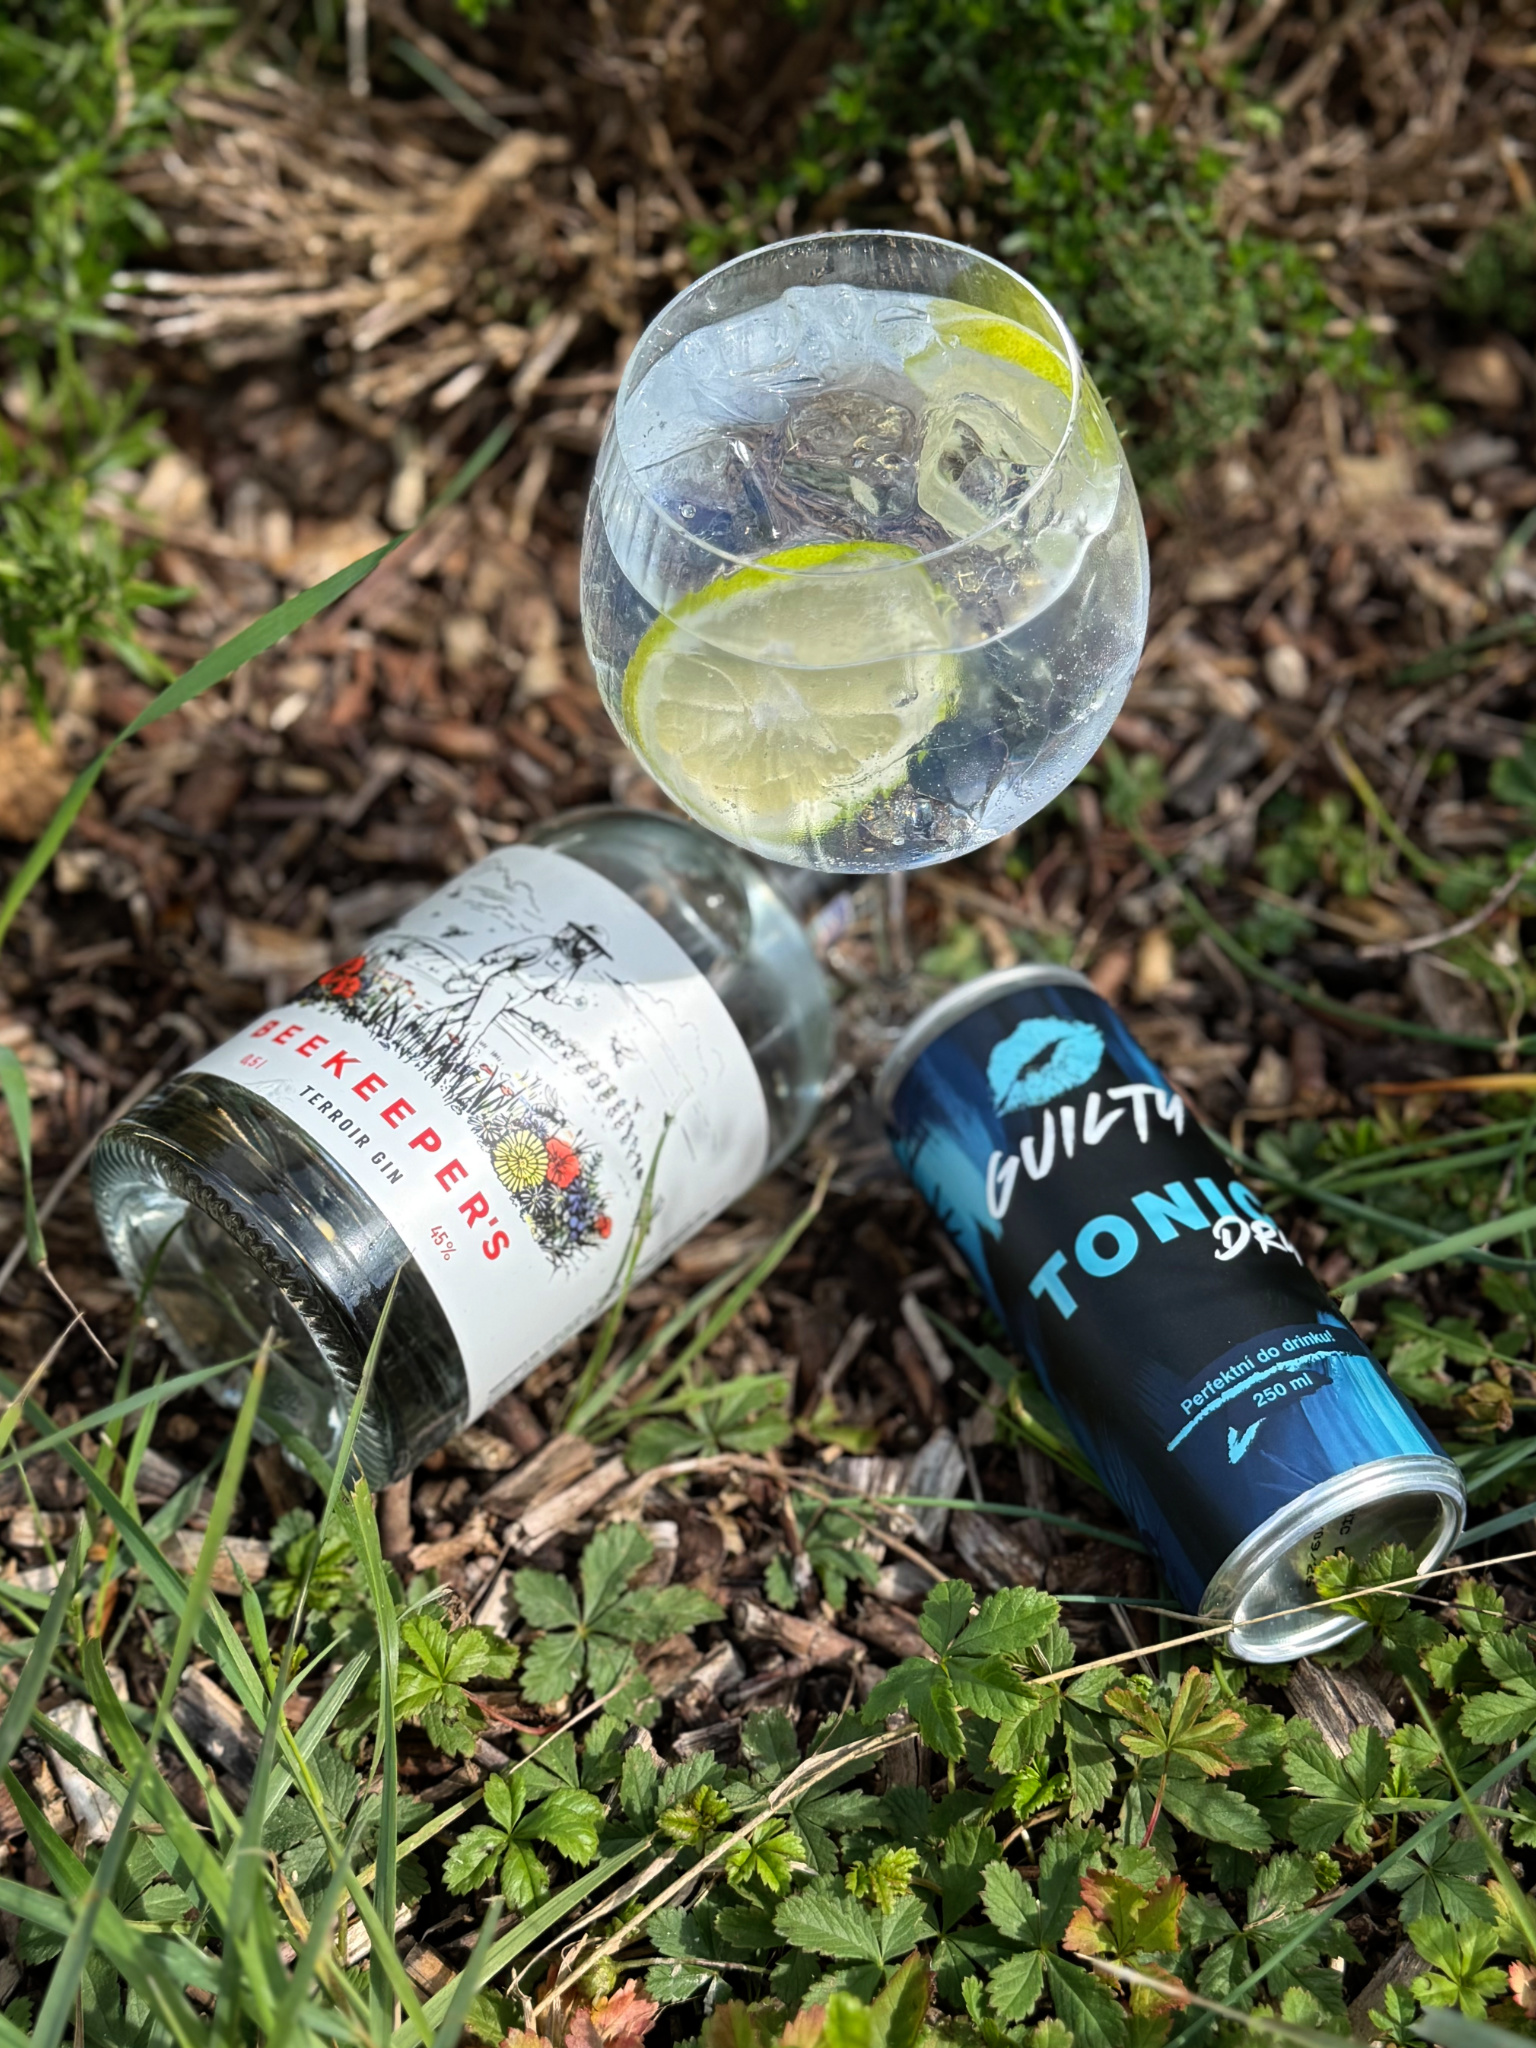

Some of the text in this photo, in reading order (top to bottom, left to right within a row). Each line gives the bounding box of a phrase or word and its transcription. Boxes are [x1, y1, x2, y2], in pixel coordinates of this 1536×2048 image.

[250, 1020, 510, 1261] BEEKEEPER'S
[299, 1085, 404, 1185] TERROIR GIN
[986, 1083, 1185, 1220] GUILTY
[430, 1225, 457, 1261] 45%
[1028, 1177, 1279, 1320] TONIC
[1180, 1330, 1336, 1415] Perfektní do drinku!
[1252, 1372, 1314, 1407] 250 ml
